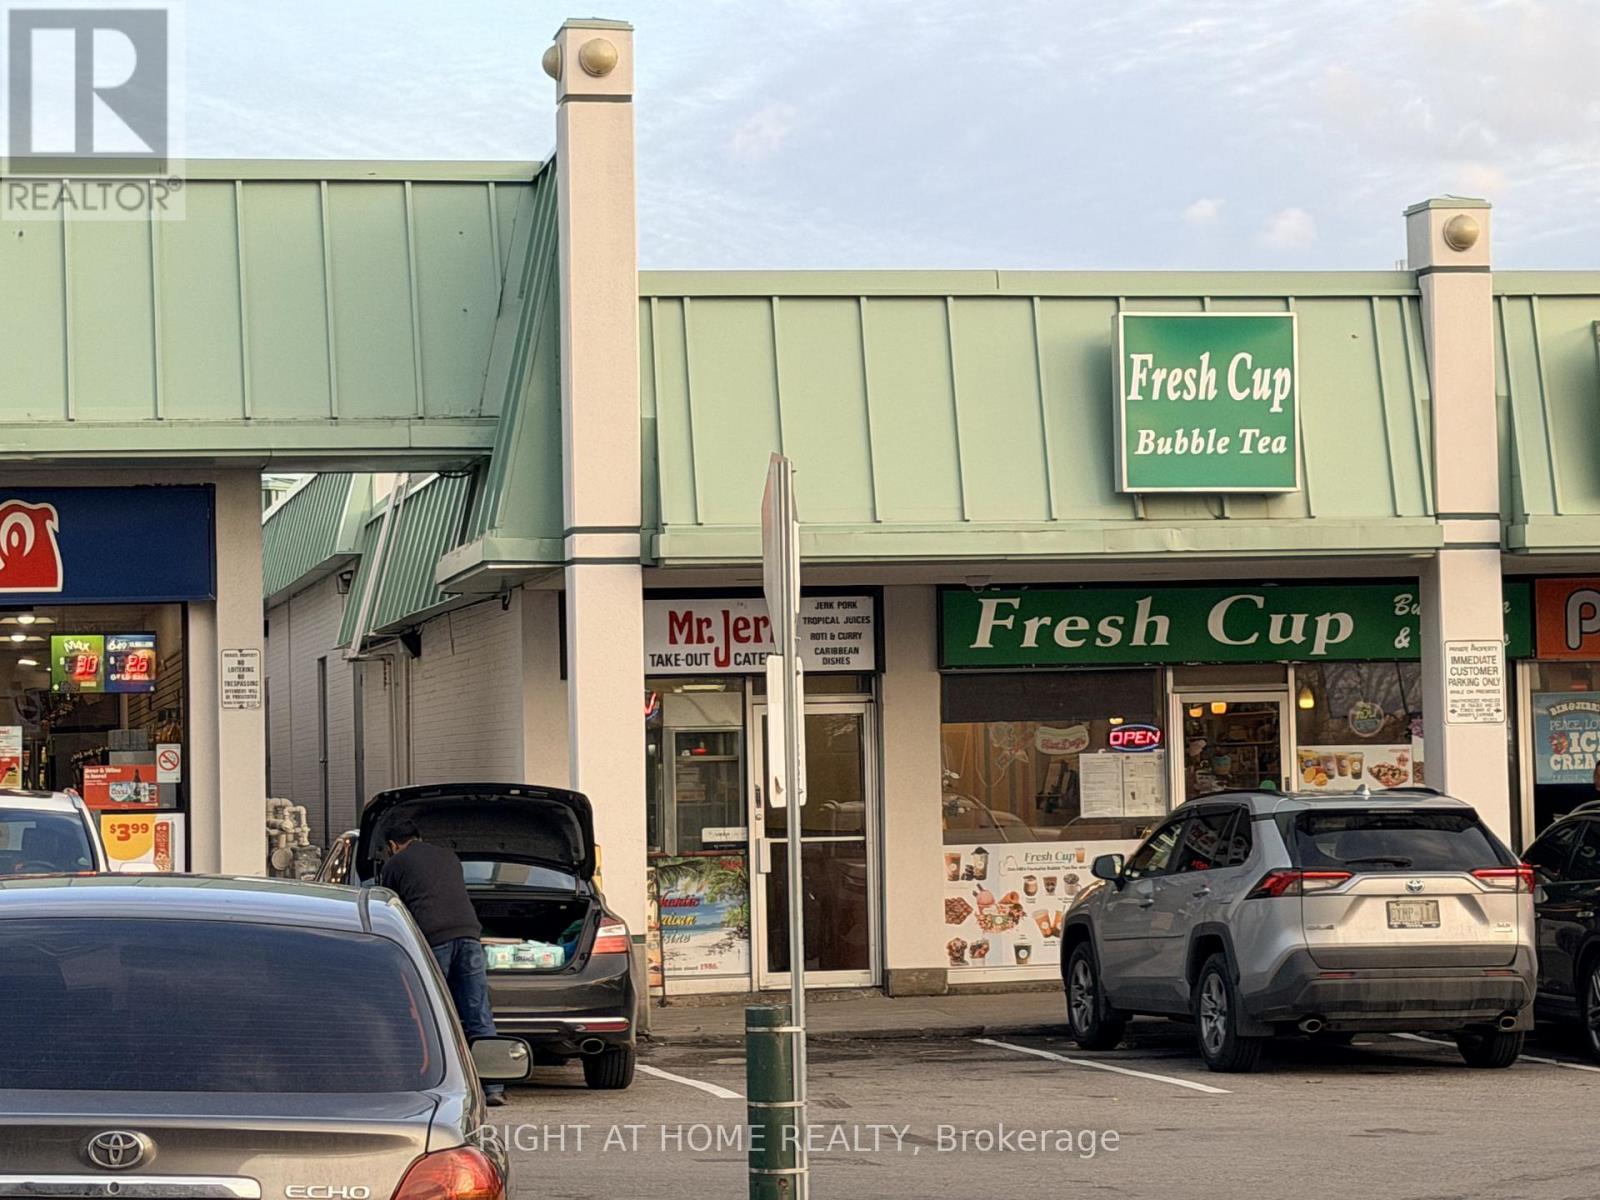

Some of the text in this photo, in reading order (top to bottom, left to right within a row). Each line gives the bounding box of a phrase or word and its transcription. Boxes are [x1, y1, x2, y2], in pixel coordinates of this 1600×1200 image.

[1127, 351, 1292, 413] Fresh Cup
[1134, 428, 1288, 455] Bubble Tea
[815, 600, 858, 610] JERK PORK
[802, 615, 871, 625] TROPICAL JUICES
[969, 596, 1171, 649] Fresh
[1207, 594, 1354, 656] Cup
[668, 609, 776, 668] Mr. Jer
[810, 632, 828, 640] ROTI
[838, 631, 862, 640] CURRY
[814, 646, 860, 655] CARIBBEAN
[649, 653, 711, 667] TAKE-OUT
[822, 656, 851, 665] DISHES
[1450, 655, 1497, 665] IMMEDIATE
[1450, 666, 1499, 676] CUSTOMER
[1448, 677, 1501, 687] PARKING ONLY
[1109, 730, 1161, 746] OPEN
[1569, 731, 1600, 753] IC
[1549, 753, 1600, 771] CREA
[1024, 851, 1076, 864] Fresh Cup
[284, 1185, 370, 1200] ECHO
